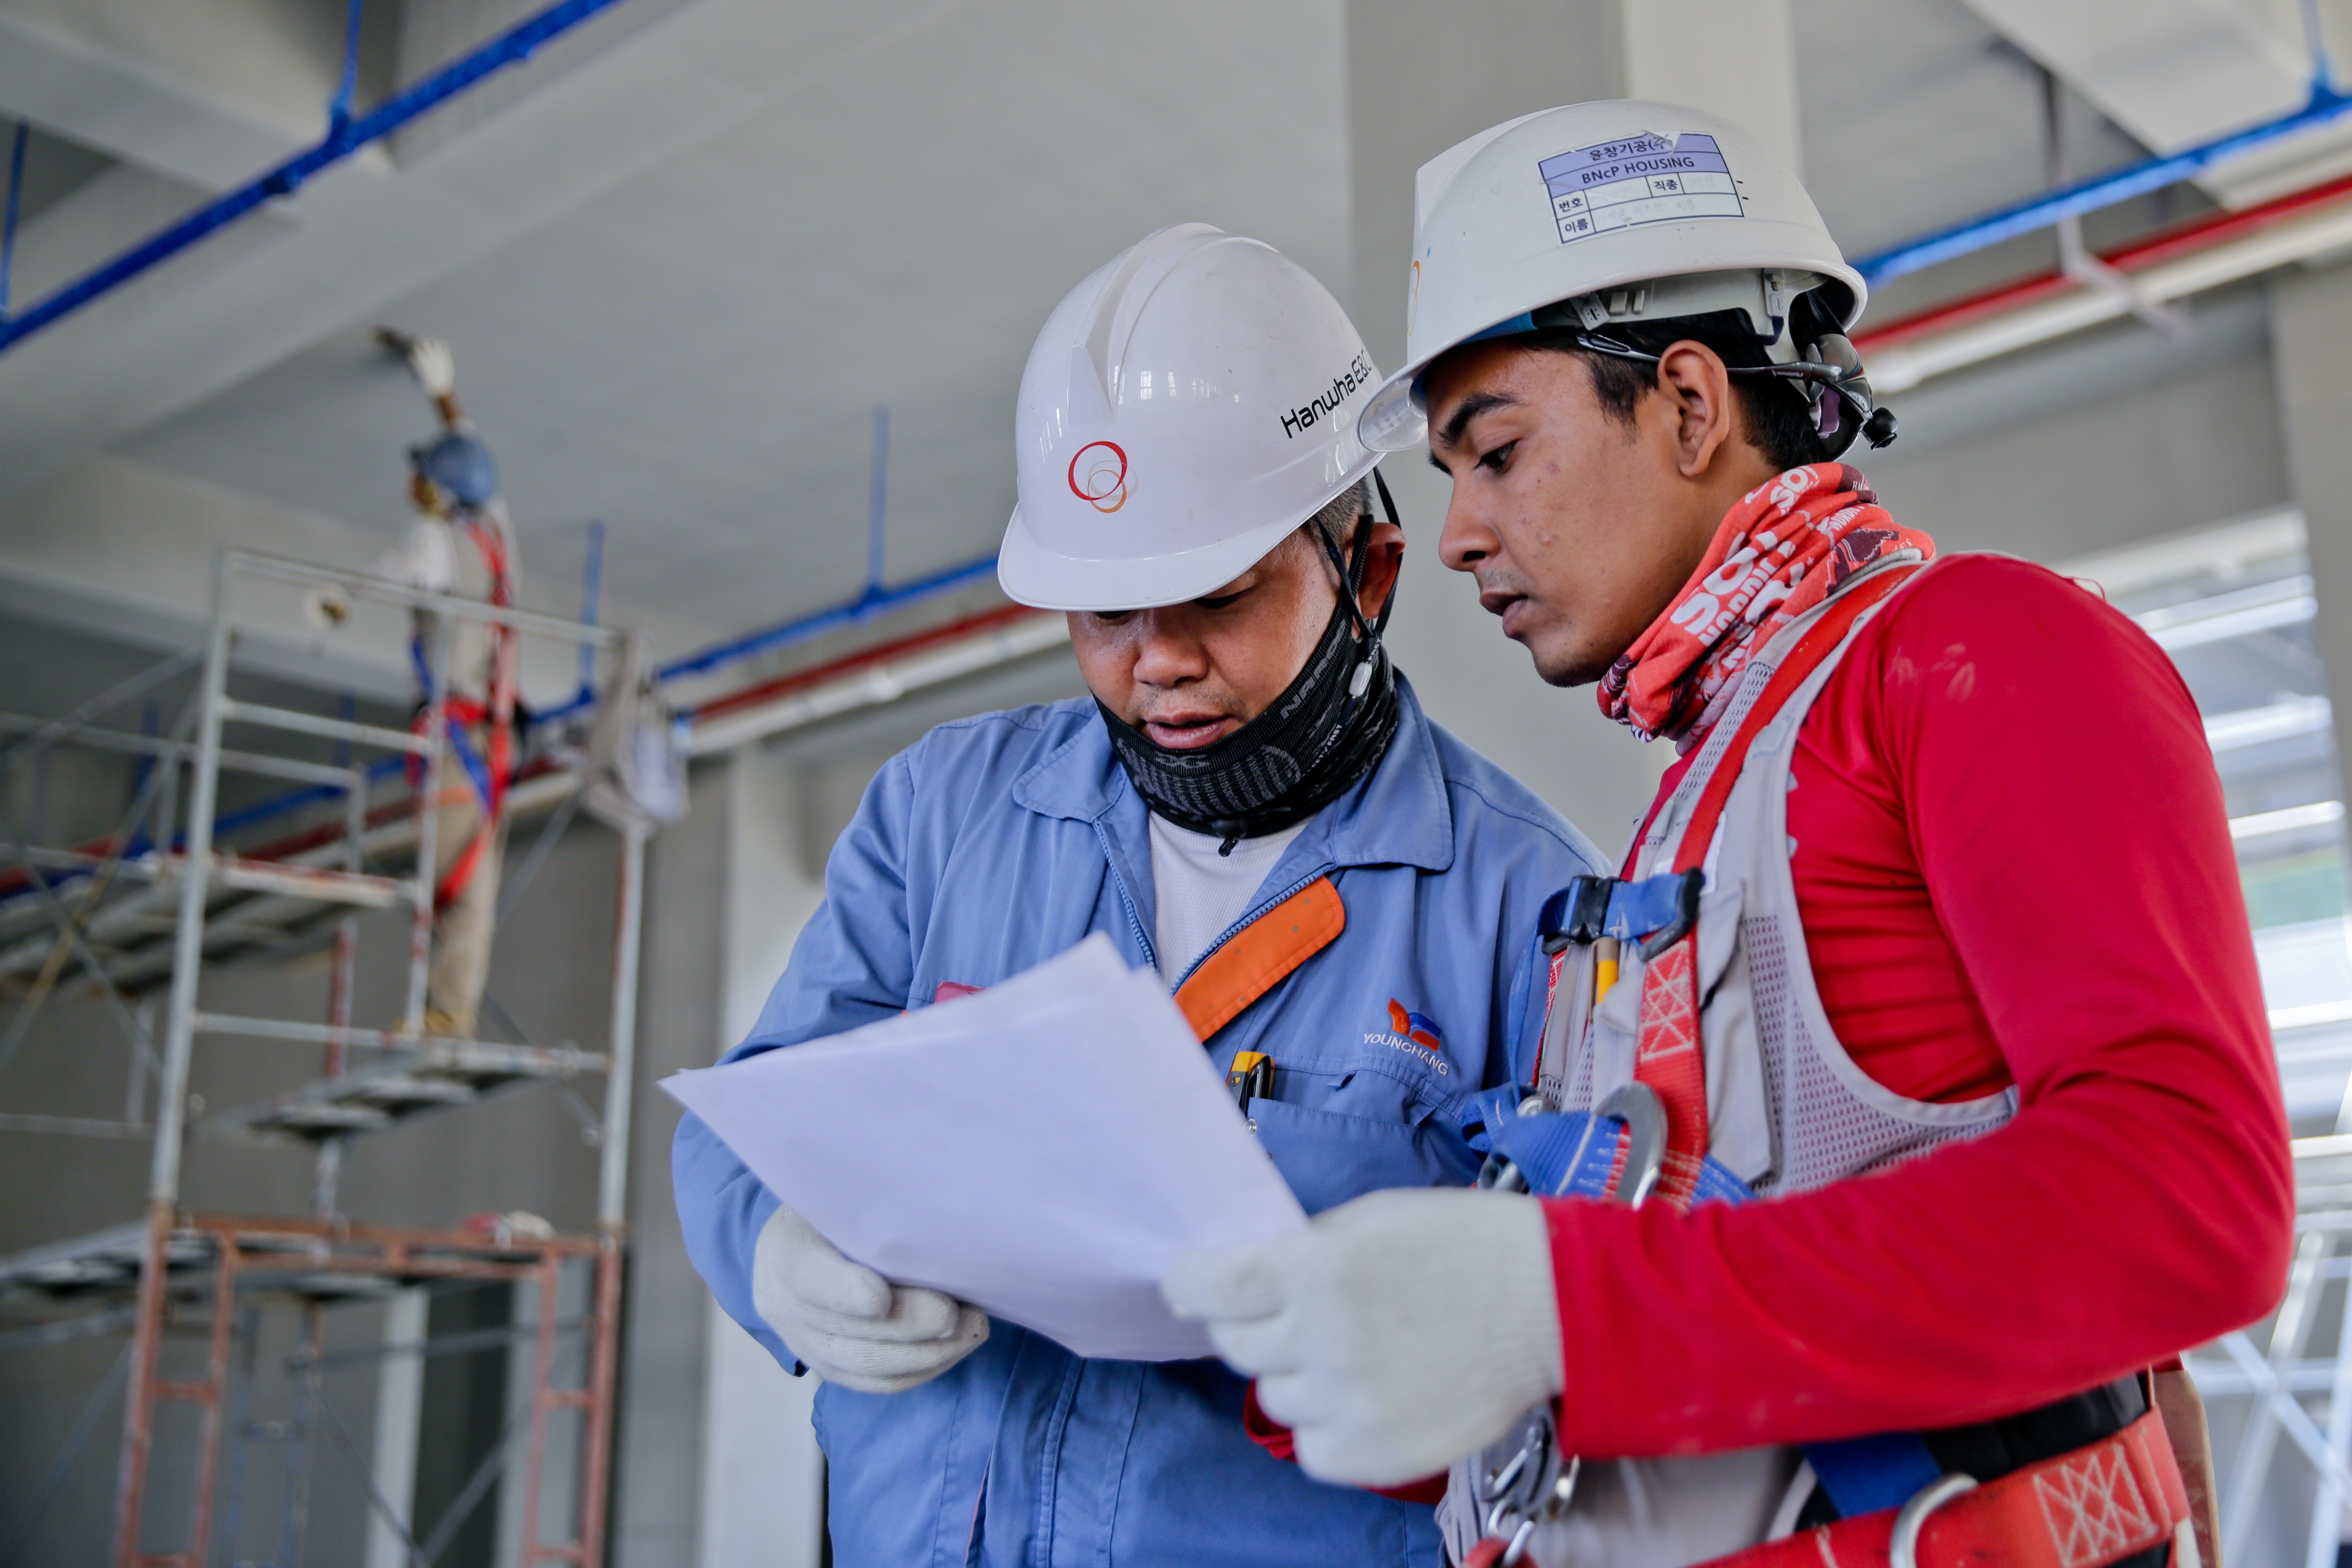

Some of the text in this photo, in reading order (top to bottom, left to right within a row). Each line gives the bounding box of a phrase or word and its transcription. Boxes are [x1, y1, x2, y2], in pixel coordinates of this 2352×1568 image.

[1581, 157, 1694, 184] BNcP HOUSING
[1654, 179, 1678, 191] 직종
[1559, 197, 1584, 212] 번호
[1565, 218, 1588, 233] 이름
[1280, 372, 1357, 439] Hanwha
[1351, 348, 1372, 385] E&C
[1363, 1033, 1450, 1076] YOUNCHANG
